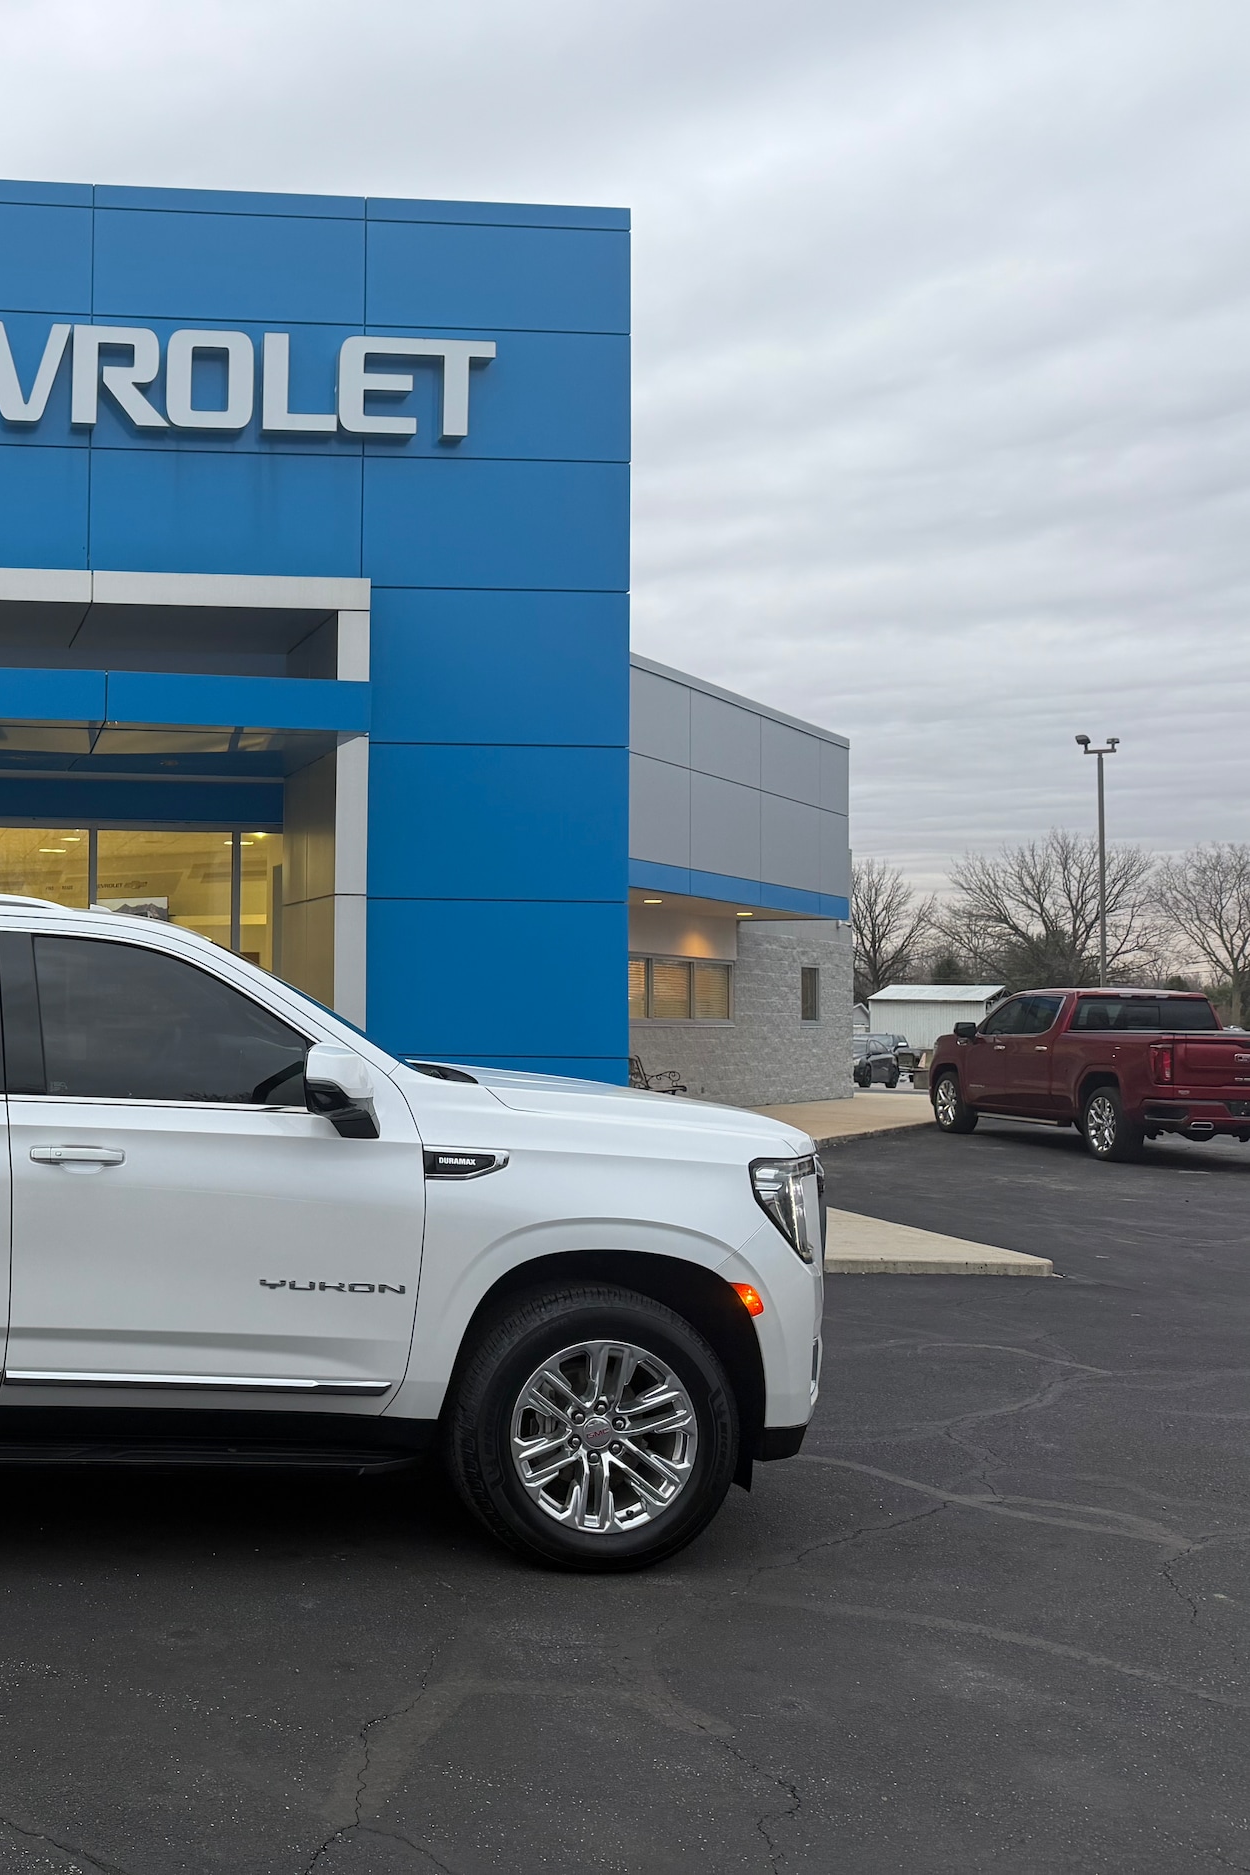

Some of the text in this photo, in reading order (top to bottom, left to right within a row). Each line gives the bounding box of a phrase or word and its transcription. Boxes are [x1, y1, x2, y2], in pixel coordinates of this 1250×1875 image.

[438, 1156, 477, 1166] DURAMAX
[259, 1278, 406, 1295] YUKON
[586, 1426, 610, 1440] GMC
